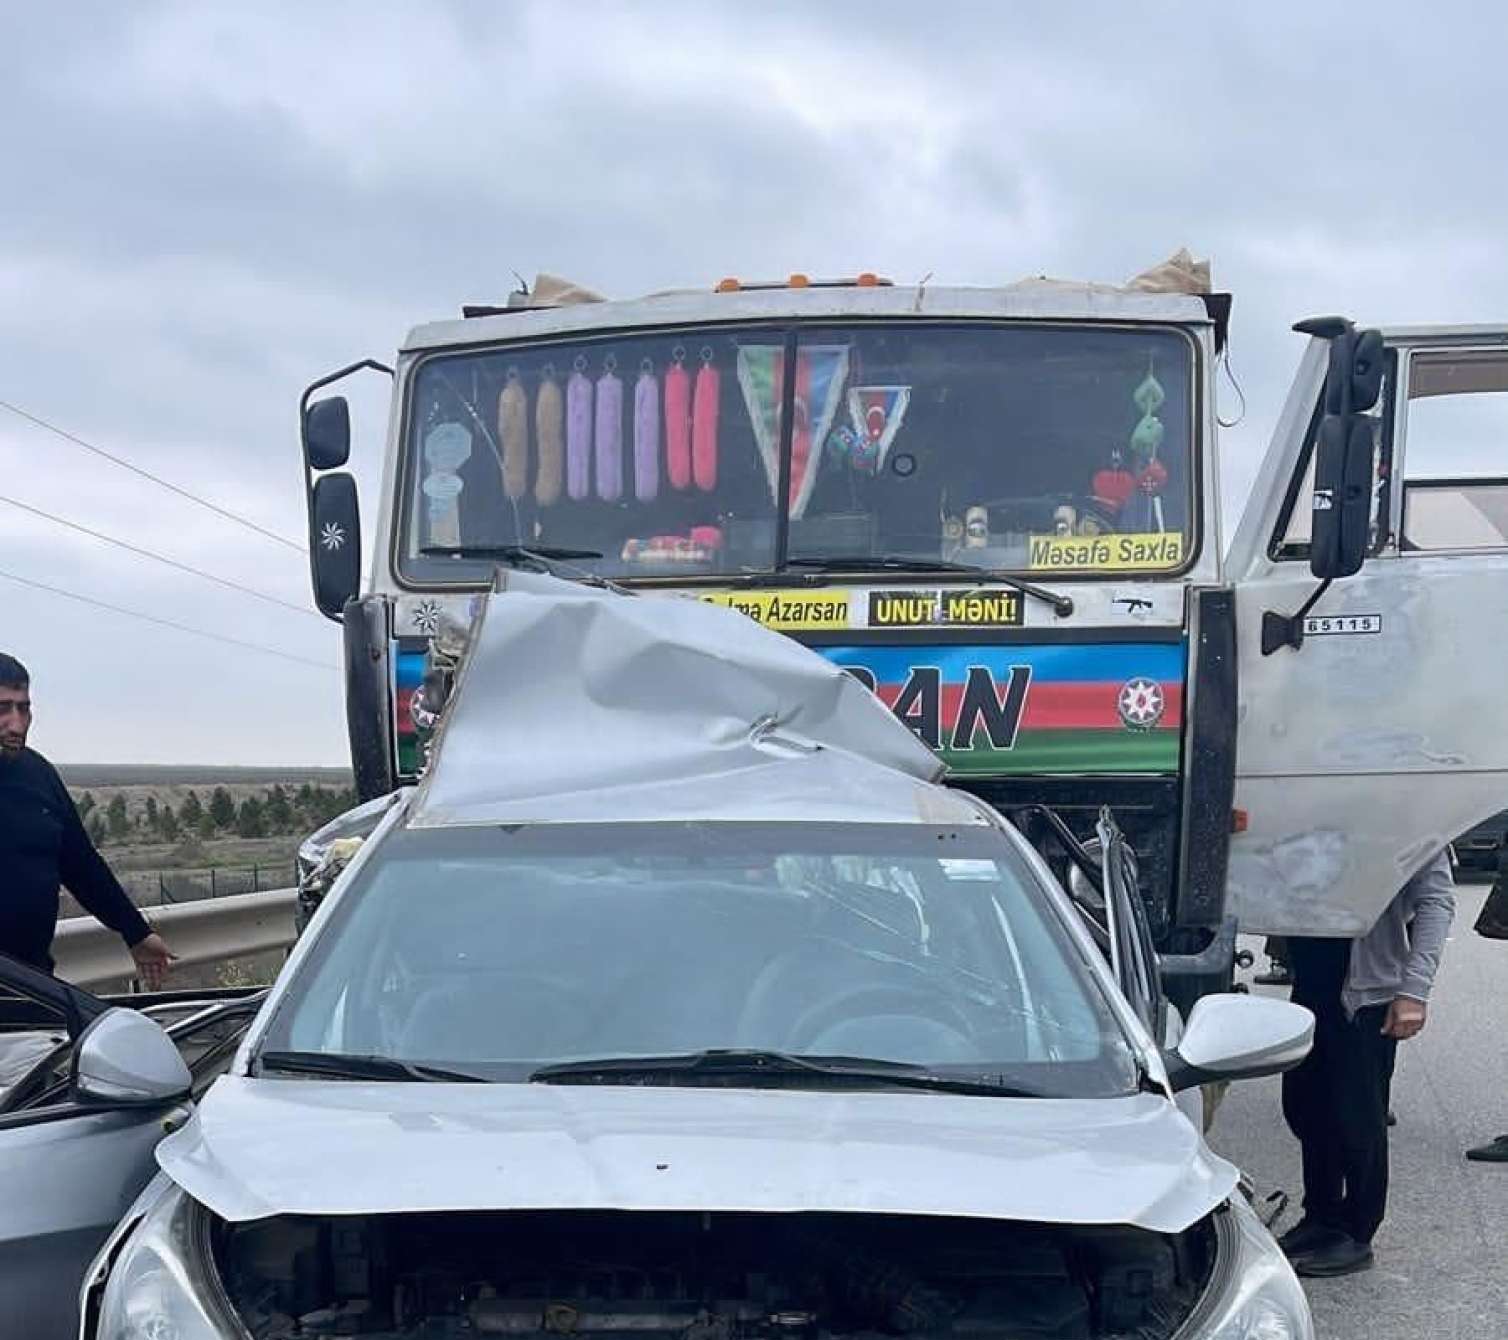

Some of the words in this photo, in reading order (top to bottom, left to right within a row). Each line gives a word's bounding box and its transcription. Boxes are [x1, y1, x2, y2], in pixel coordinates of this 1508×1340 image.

[1031, 540, 1110, 566] Məsafə
[1118, 537, 1178, 562] Saxla
[766, 596, 848, 623] Azarsan
[876, 598, 936, 623] UNUT
[949, 593, 1017, 622] MƏNİ!
[1308, 618, 1372, 632] 65115
[842, 664, 1032, 752] AN
